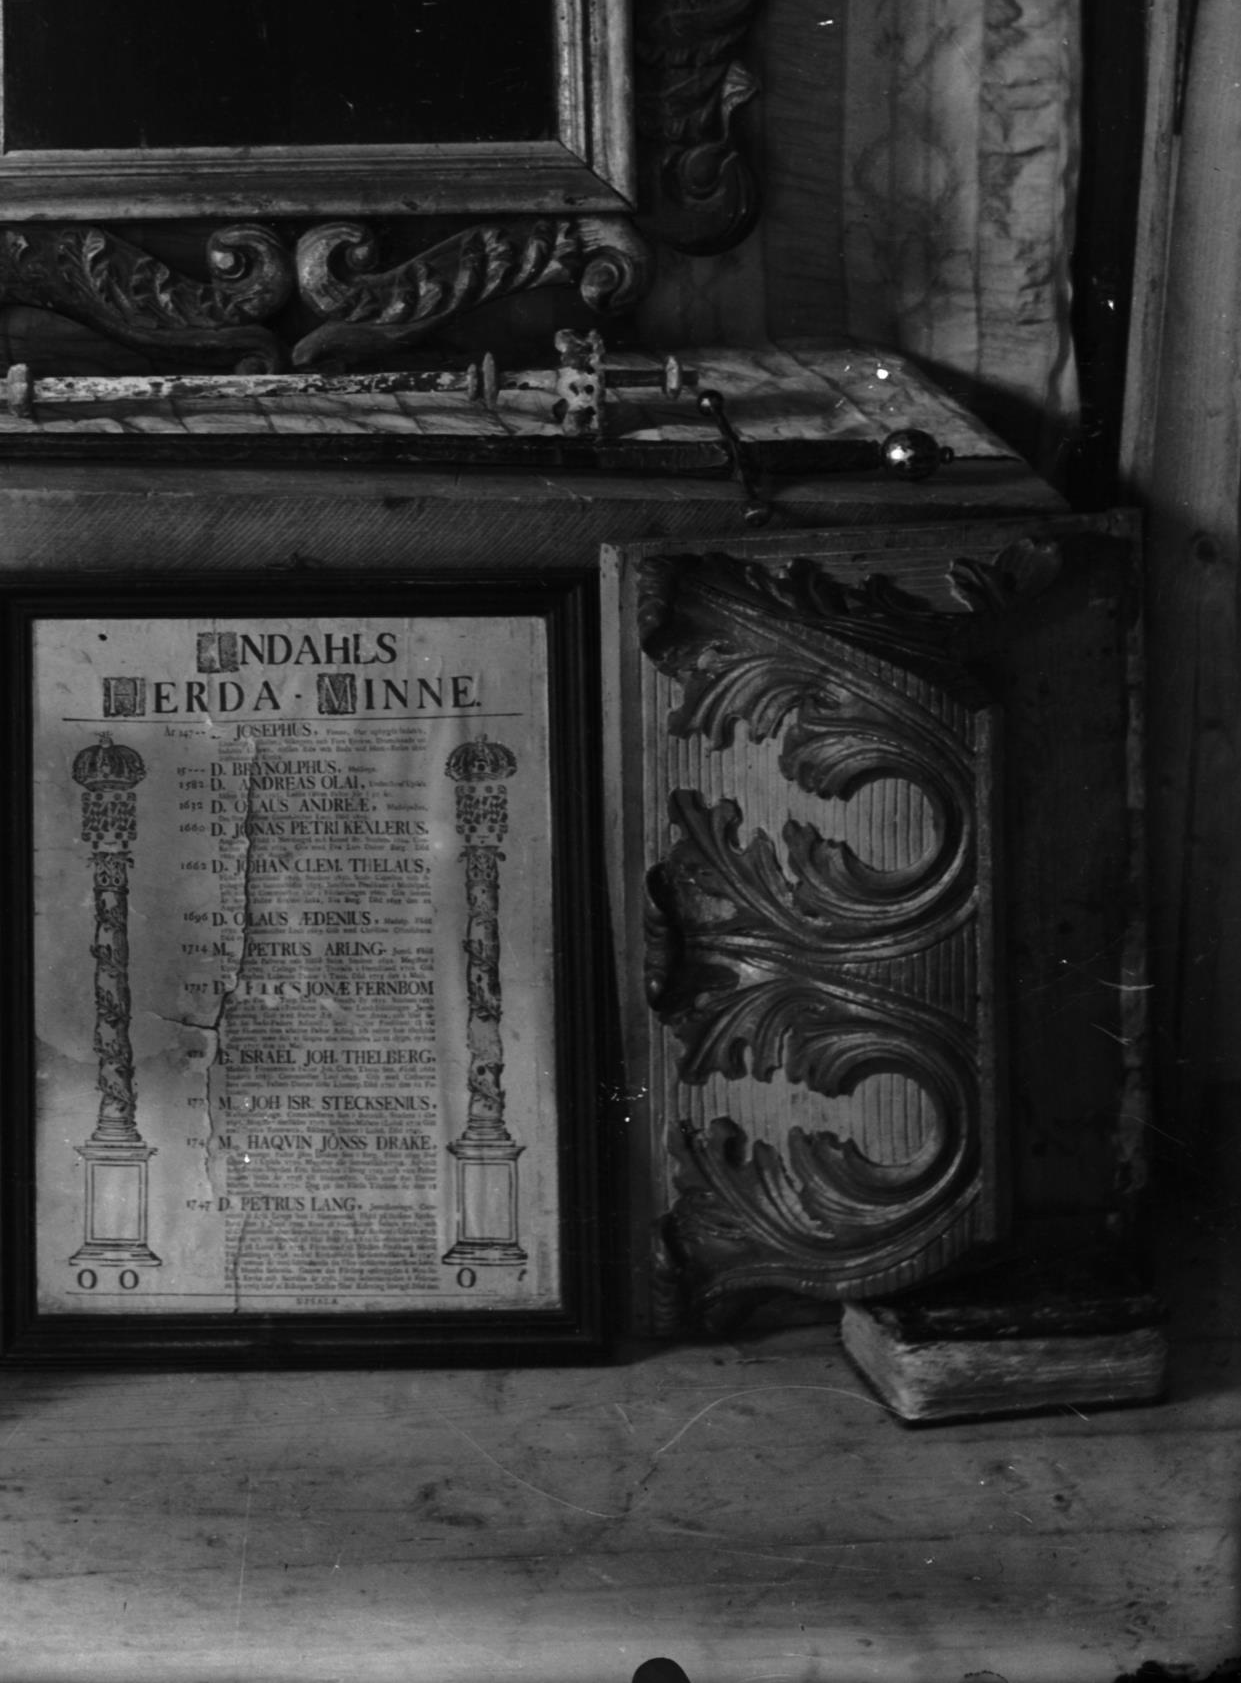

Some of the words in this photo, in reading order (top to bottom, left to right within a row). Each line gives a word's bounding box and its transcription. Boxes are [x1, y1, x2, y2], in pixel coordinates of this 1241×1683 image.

[240, 776, 316, 791] ANDREAS
[231, 821, 286, 839] JONAS
[290, 820, 340, 836] PETRI
[234, 858, 290, 876] JOHAN
[233, 911, 289, 926] OLAUS
[247, 942, 313, 957] PETRUS
[355, 980, 435, 996] FERNBOM
[240, 1049, 296, 1065] ISRAEL
[248, 1135, 312, 1151] HAQVIN
[241, 1197, 305, 1212] PETRUS
